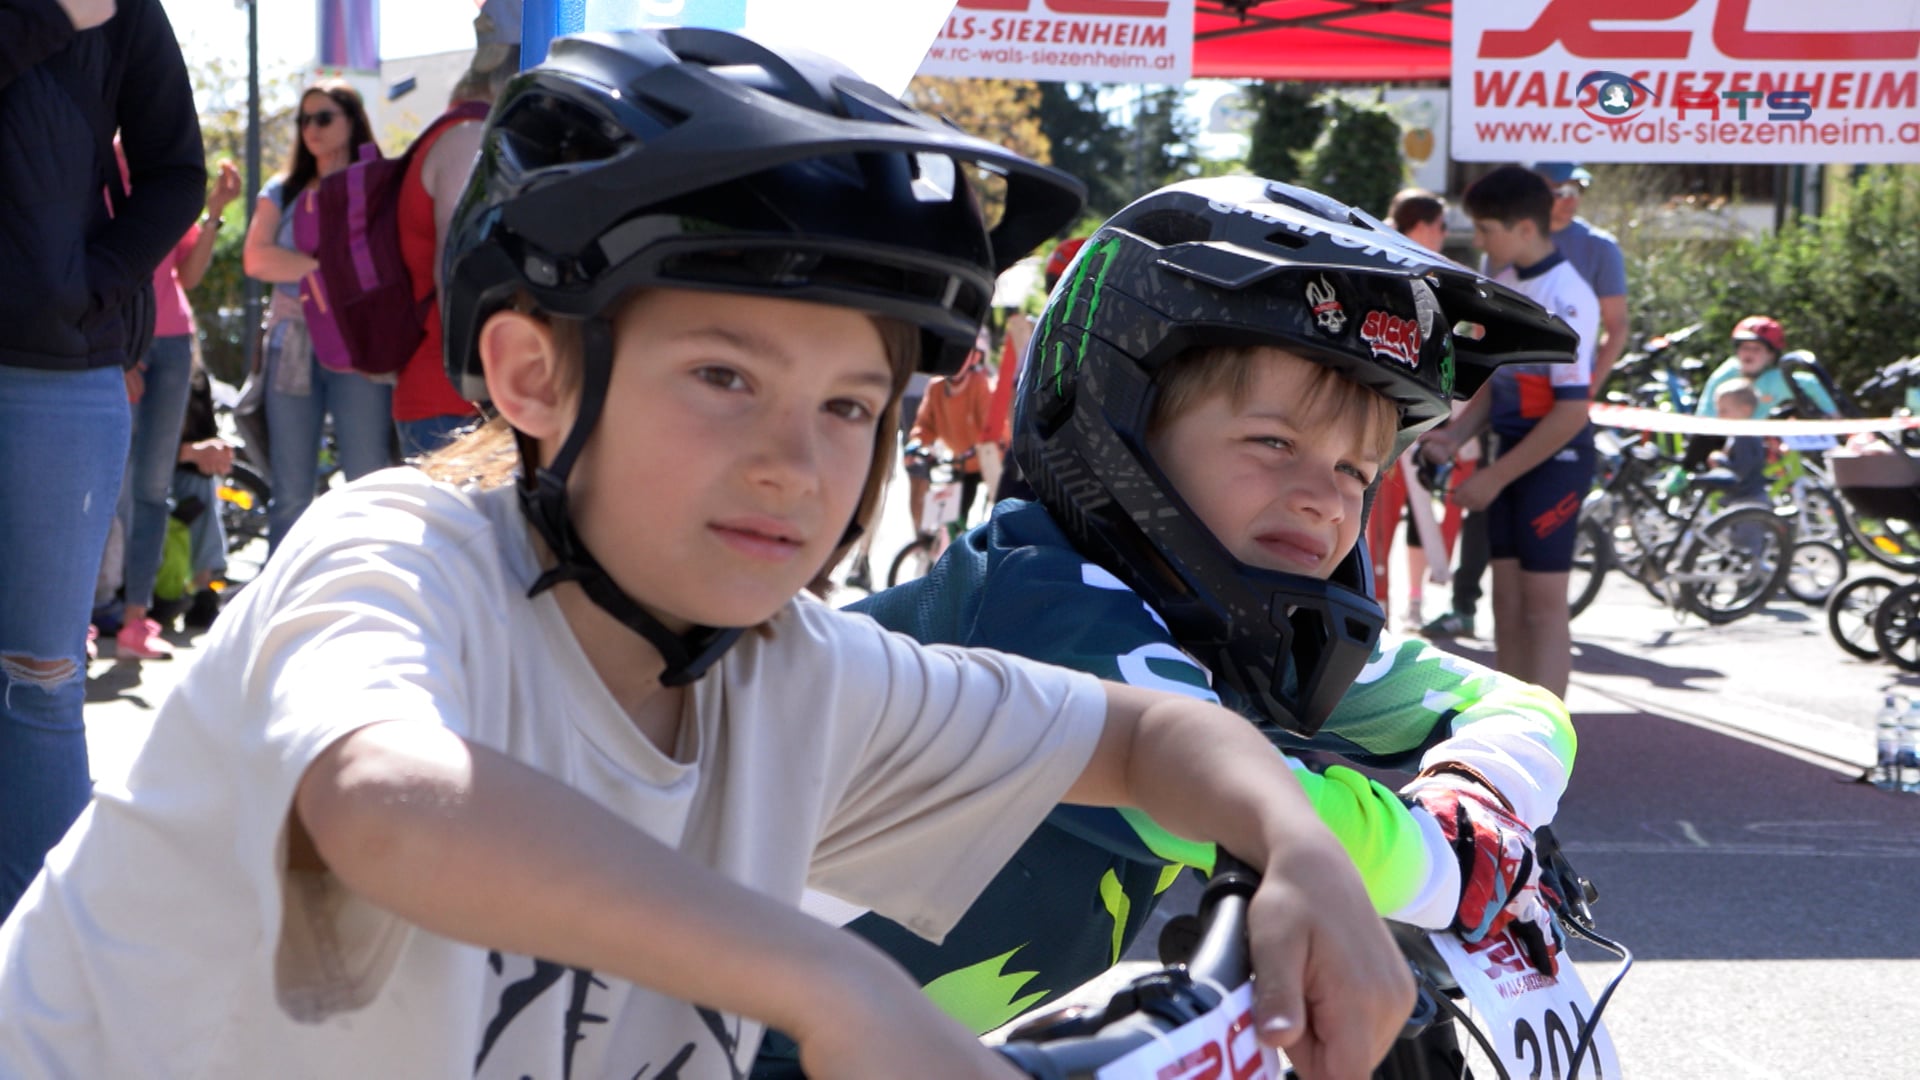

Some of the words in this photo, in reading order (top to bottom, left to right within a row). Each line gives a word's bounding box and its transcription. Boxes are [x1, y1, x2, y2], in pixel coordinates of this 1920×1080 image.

[937, 17, 1168, 47] LS-SIEZENHEIM
[928, 46, 1176, 70] w.rc-wals-siezenheim.at
[1473, 70, 1918, 110] WALSSIEZENHEIM
[1475, 117, 1920, 145] www.rc-wals-siezenheim.a
